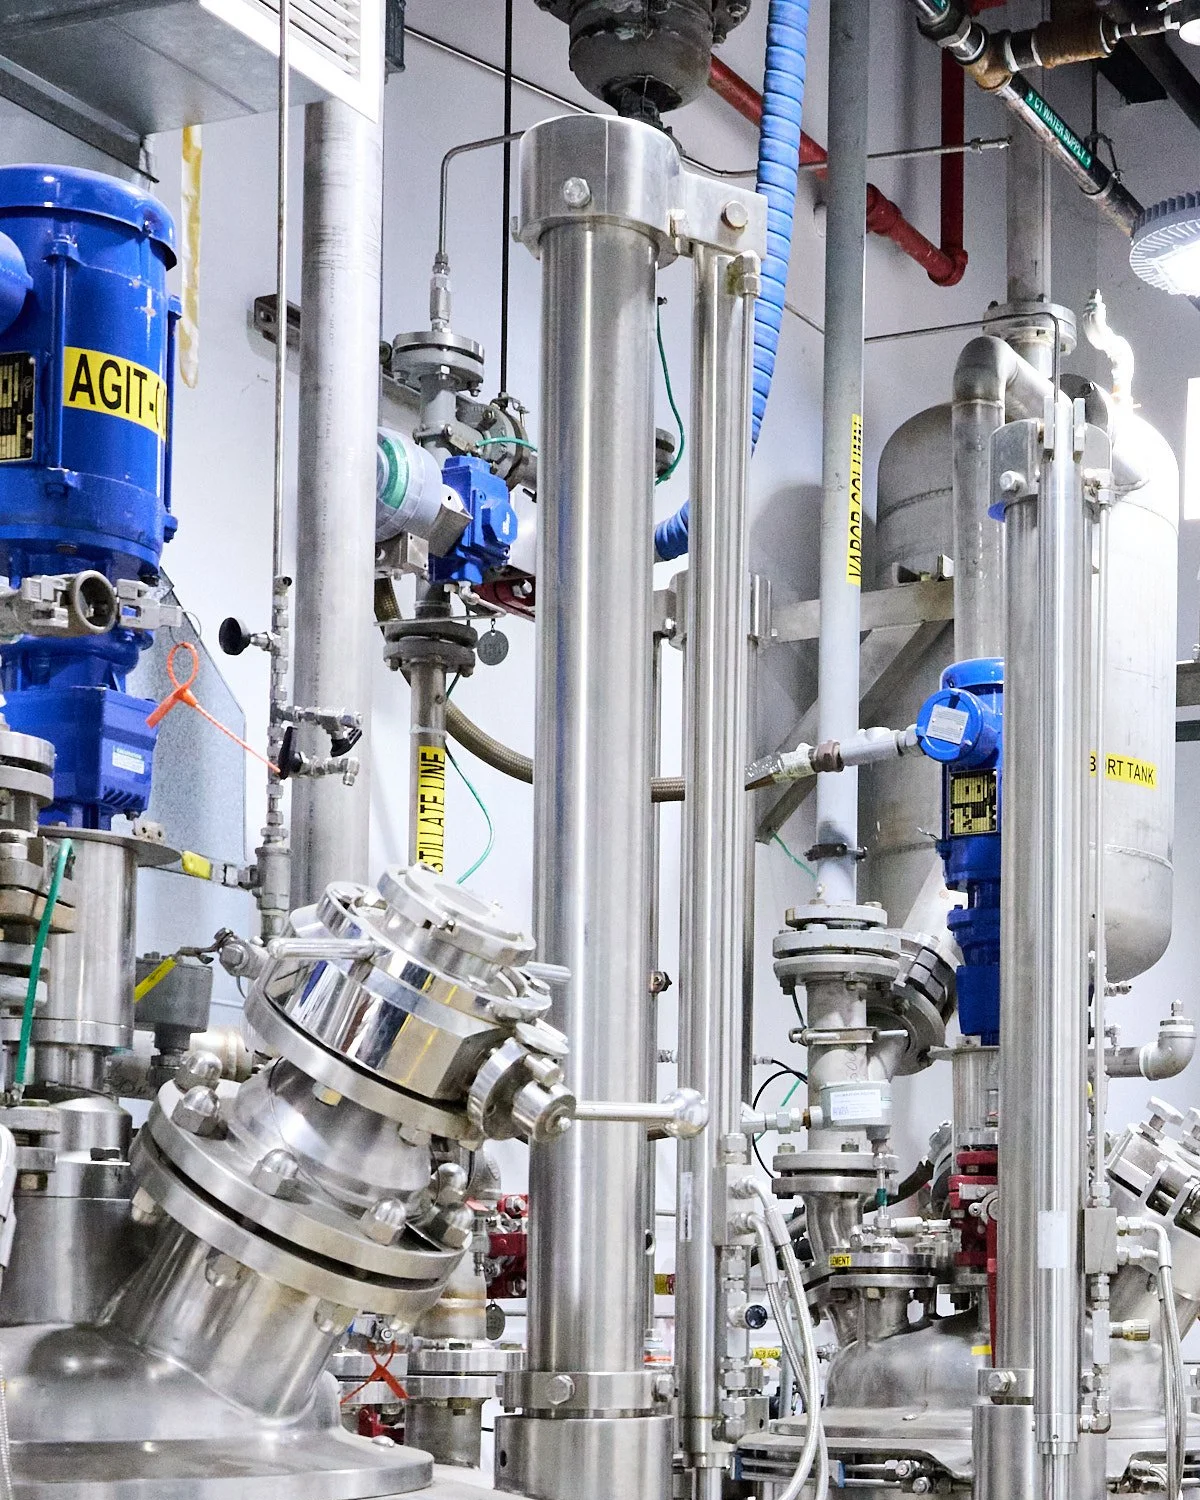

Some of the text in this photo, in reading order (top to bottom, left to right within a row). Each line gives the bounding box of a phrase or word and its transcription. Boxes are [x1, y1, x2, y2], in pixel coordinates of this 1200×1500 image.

[1043, 105, 1065, 136] WATER
[1063, 128, 1087, 160] SUPPLY
[420, 752, 446, 790] LINE
[1127, 762, 1154, 785] TANK
